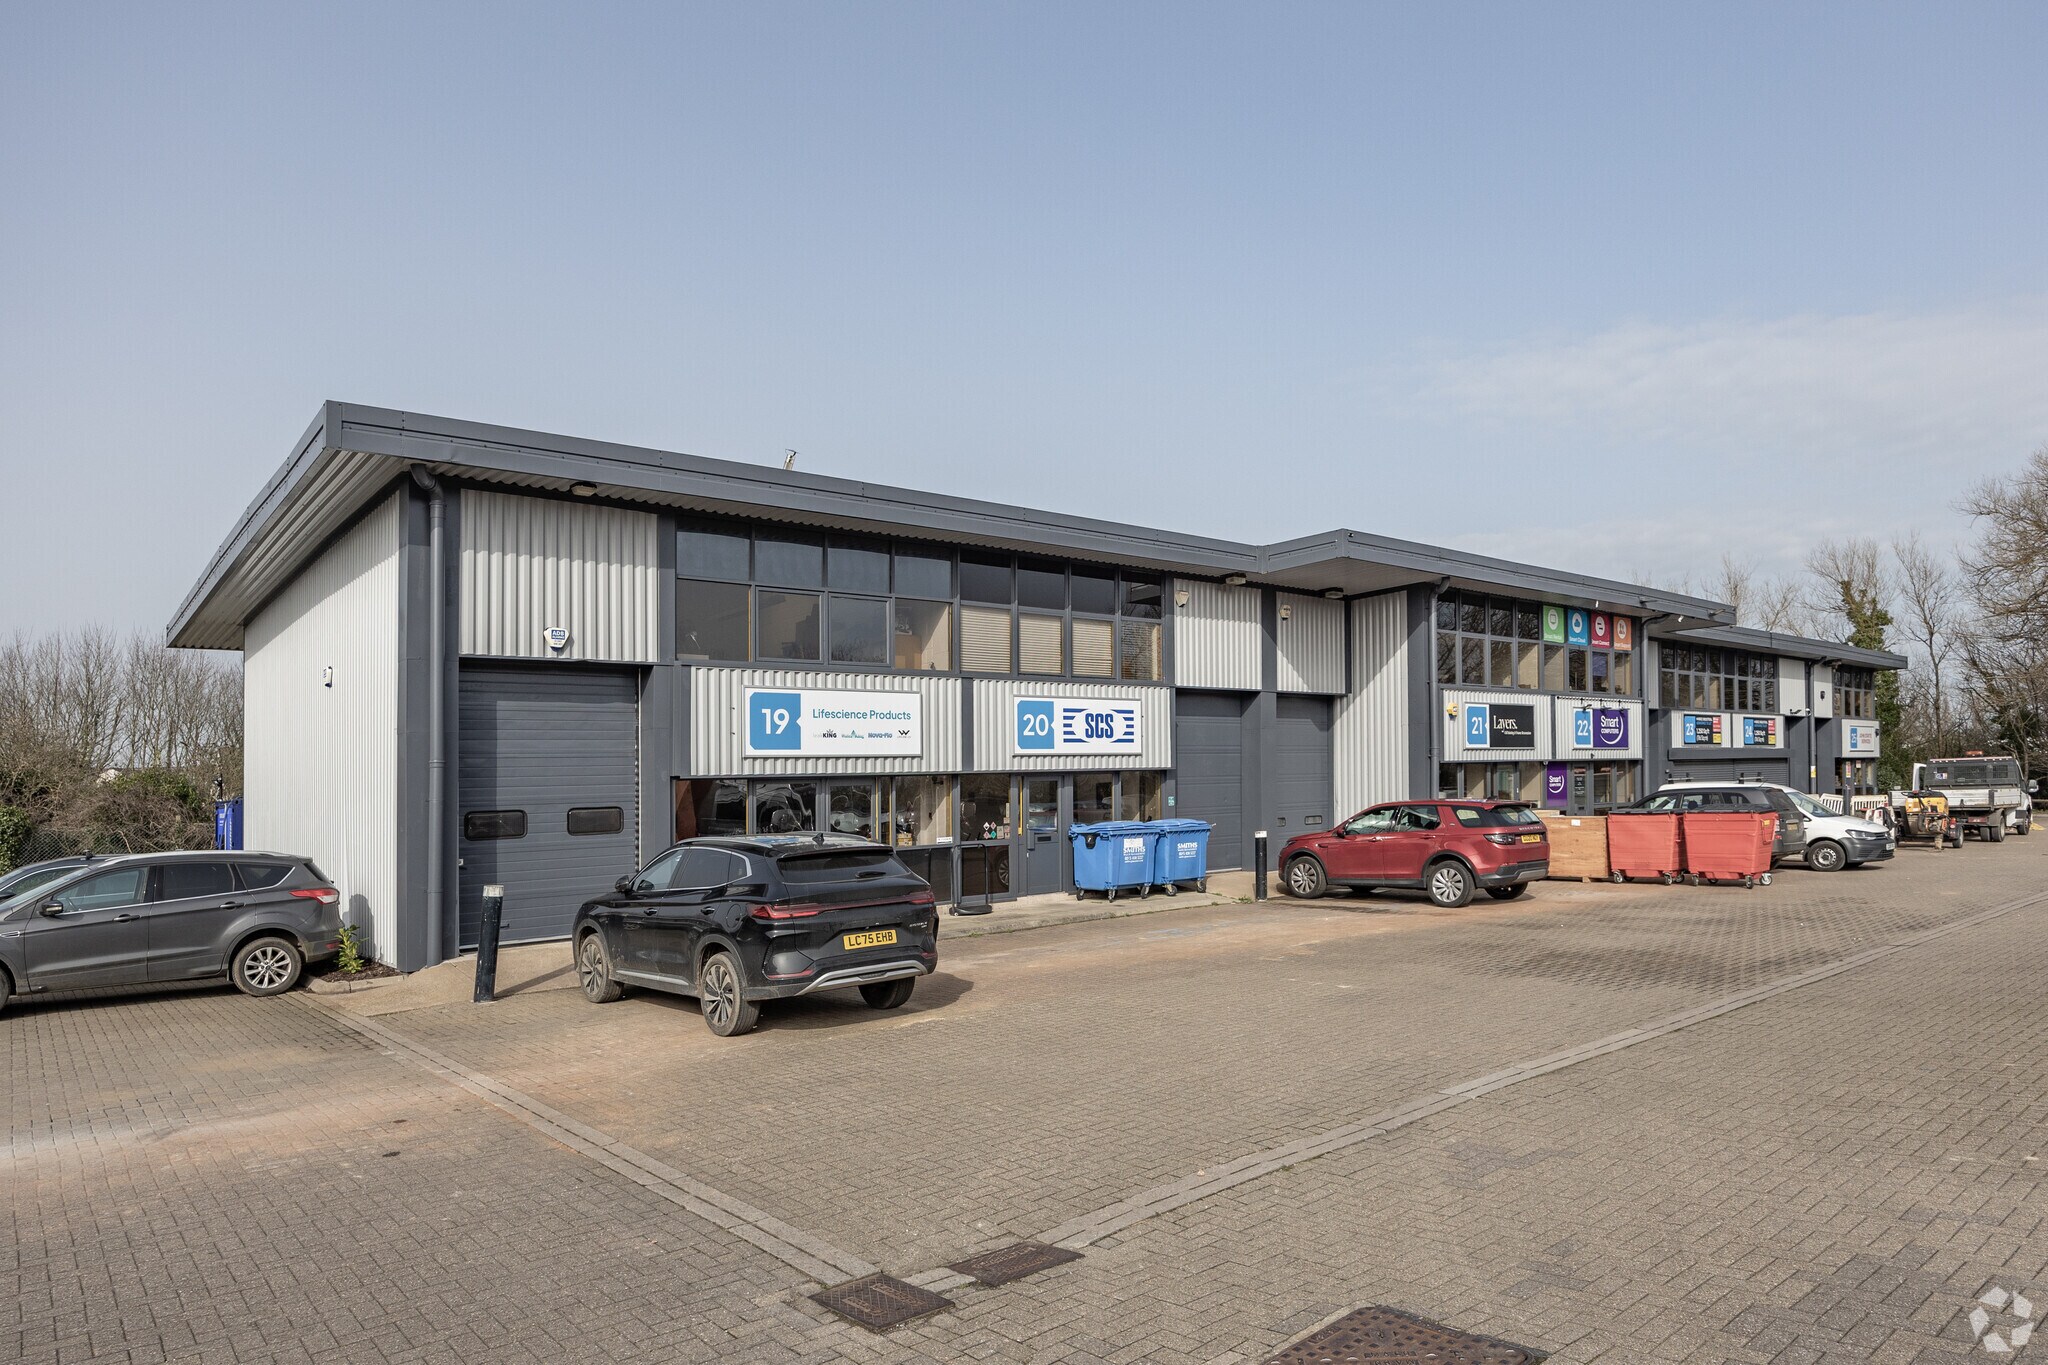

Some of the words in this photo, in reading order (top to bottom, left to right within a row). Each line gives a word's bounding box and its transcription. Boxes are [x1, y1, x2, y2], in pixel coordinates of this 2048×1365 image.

[761, 708, 790, 735] 19
[812, 708, 868, 719] Lifescience
[869, 709, 912, 720] Products
[1600, 715, 1619, 727] Smart
[1022, 713, 1049, 737] 20
[1085, 713, 1114, 738] SCS
[1471, 716, 1483, 735] 21
[1577, 720, 1589, 736] 22
[1685, 723, 1694, 736] 23
[1745, 726, 1754, 737] 24
[1549, 775, 1562, 783] Smart
[848, 934, 874, 947] LC75
[875, 931, 894, 943] EHB
